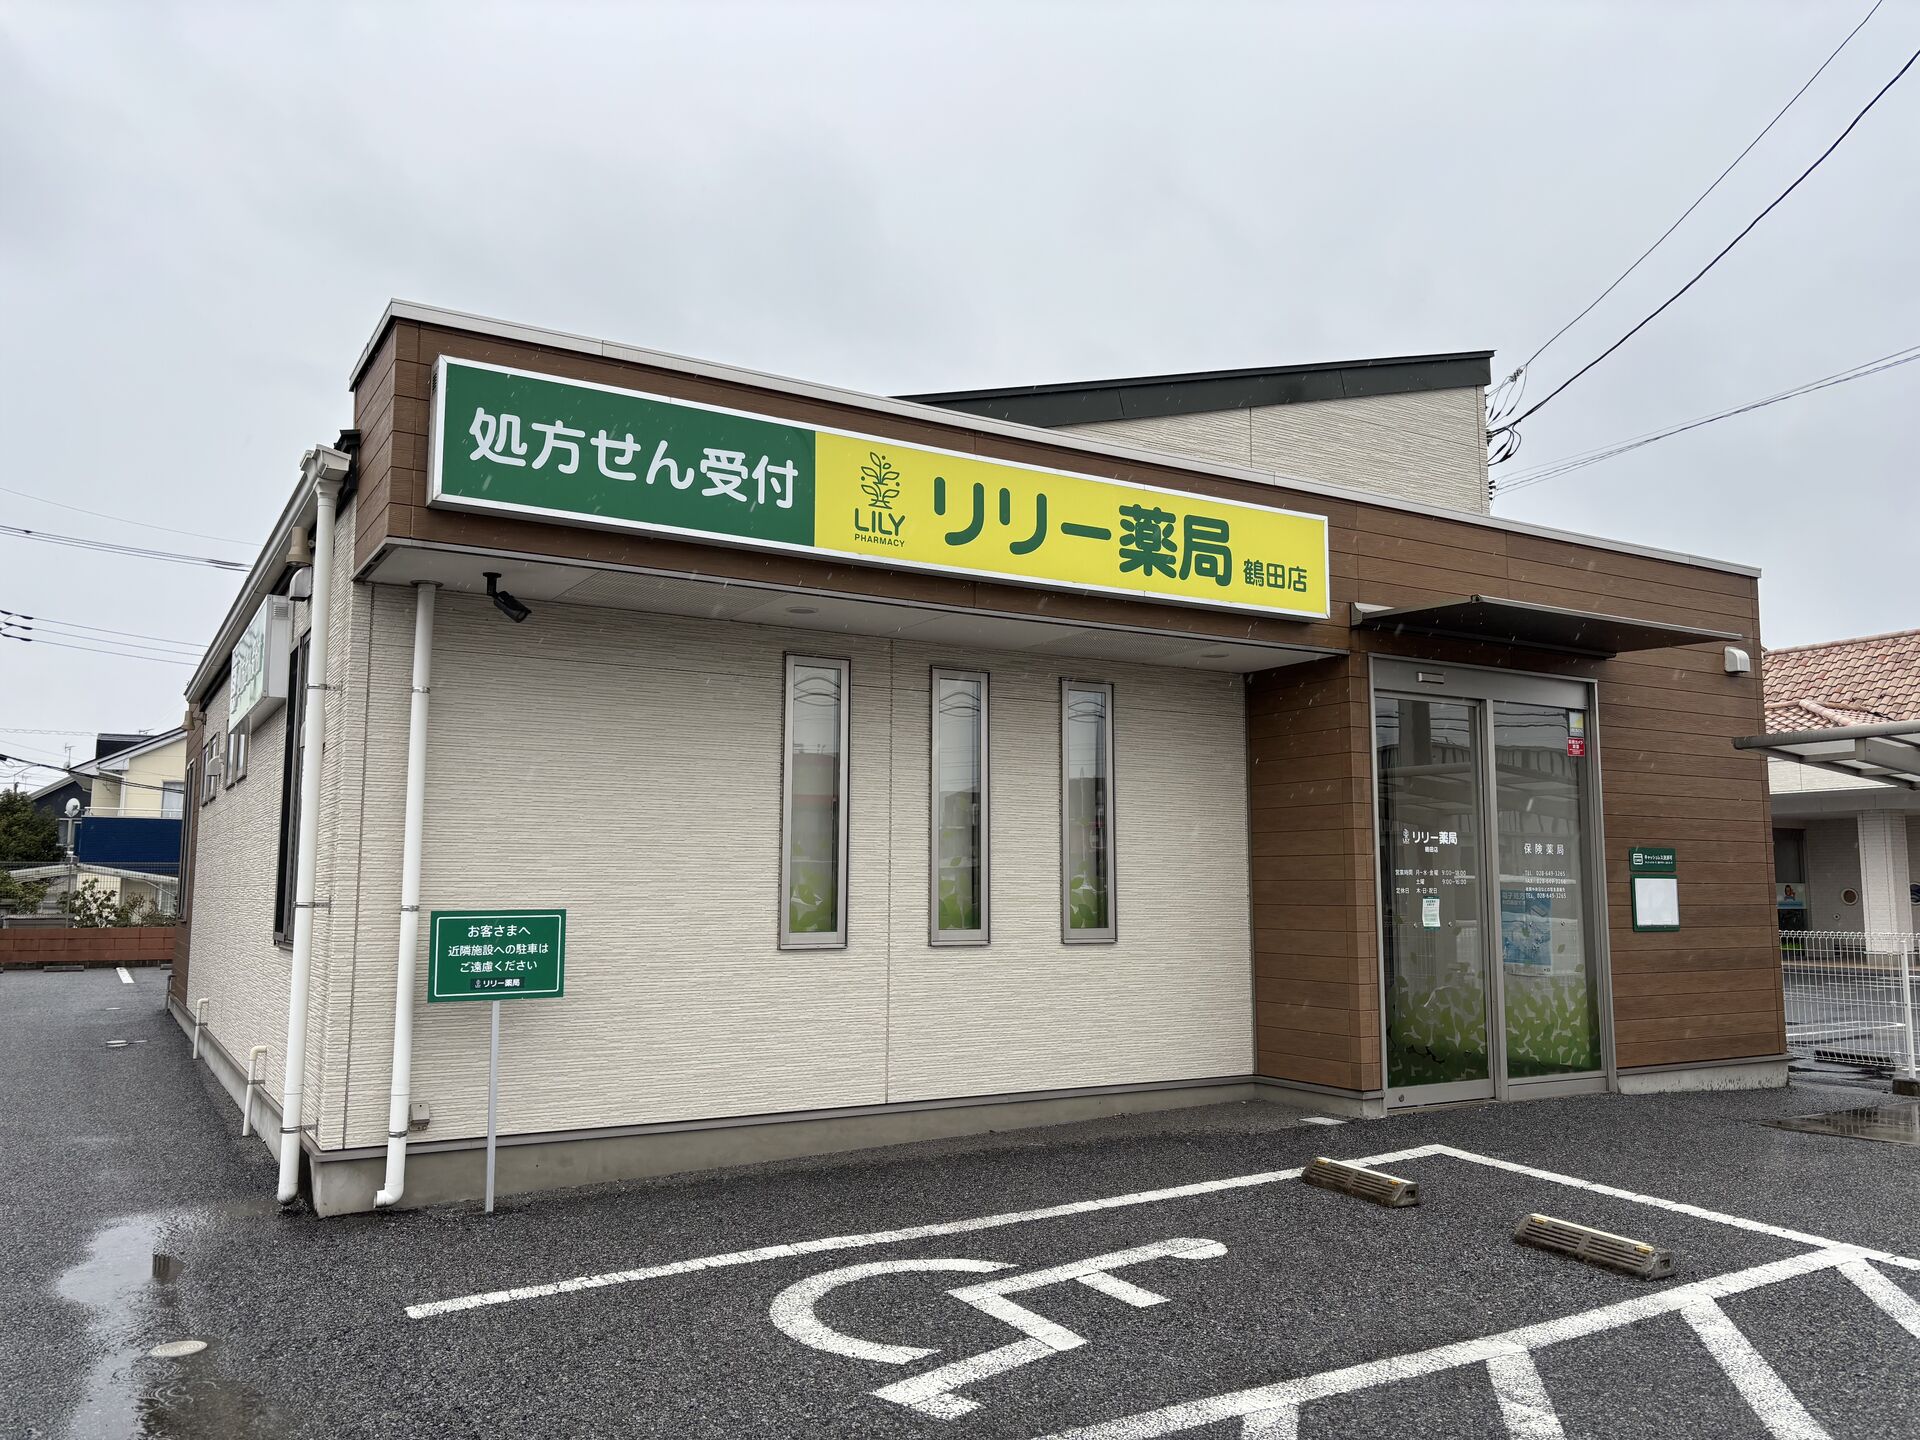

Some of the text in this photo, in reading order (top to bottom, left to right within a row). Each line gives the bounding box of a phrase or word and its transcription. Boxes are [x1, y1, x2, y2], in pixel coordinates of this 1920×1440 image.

[469, 406, 799, 509] 処方せん受付
[855, 507, 905, 536] LILY
[854, 533, 905, 547] PHARMACY
[934, 476, 1307, 592] リリー薬局 鶴田店
[1412, 831, 1458, 845] リリー薬局
[1524, 843, 1565, 855] 保険薬局
[467, 925, 531, 938] お客さまへ
[448, 943, 549, 957] 近隣施設への駐車は
[460, 961, 538, 973] ご遠慮ください
[483, 978, 521, 988] リリー薬局
